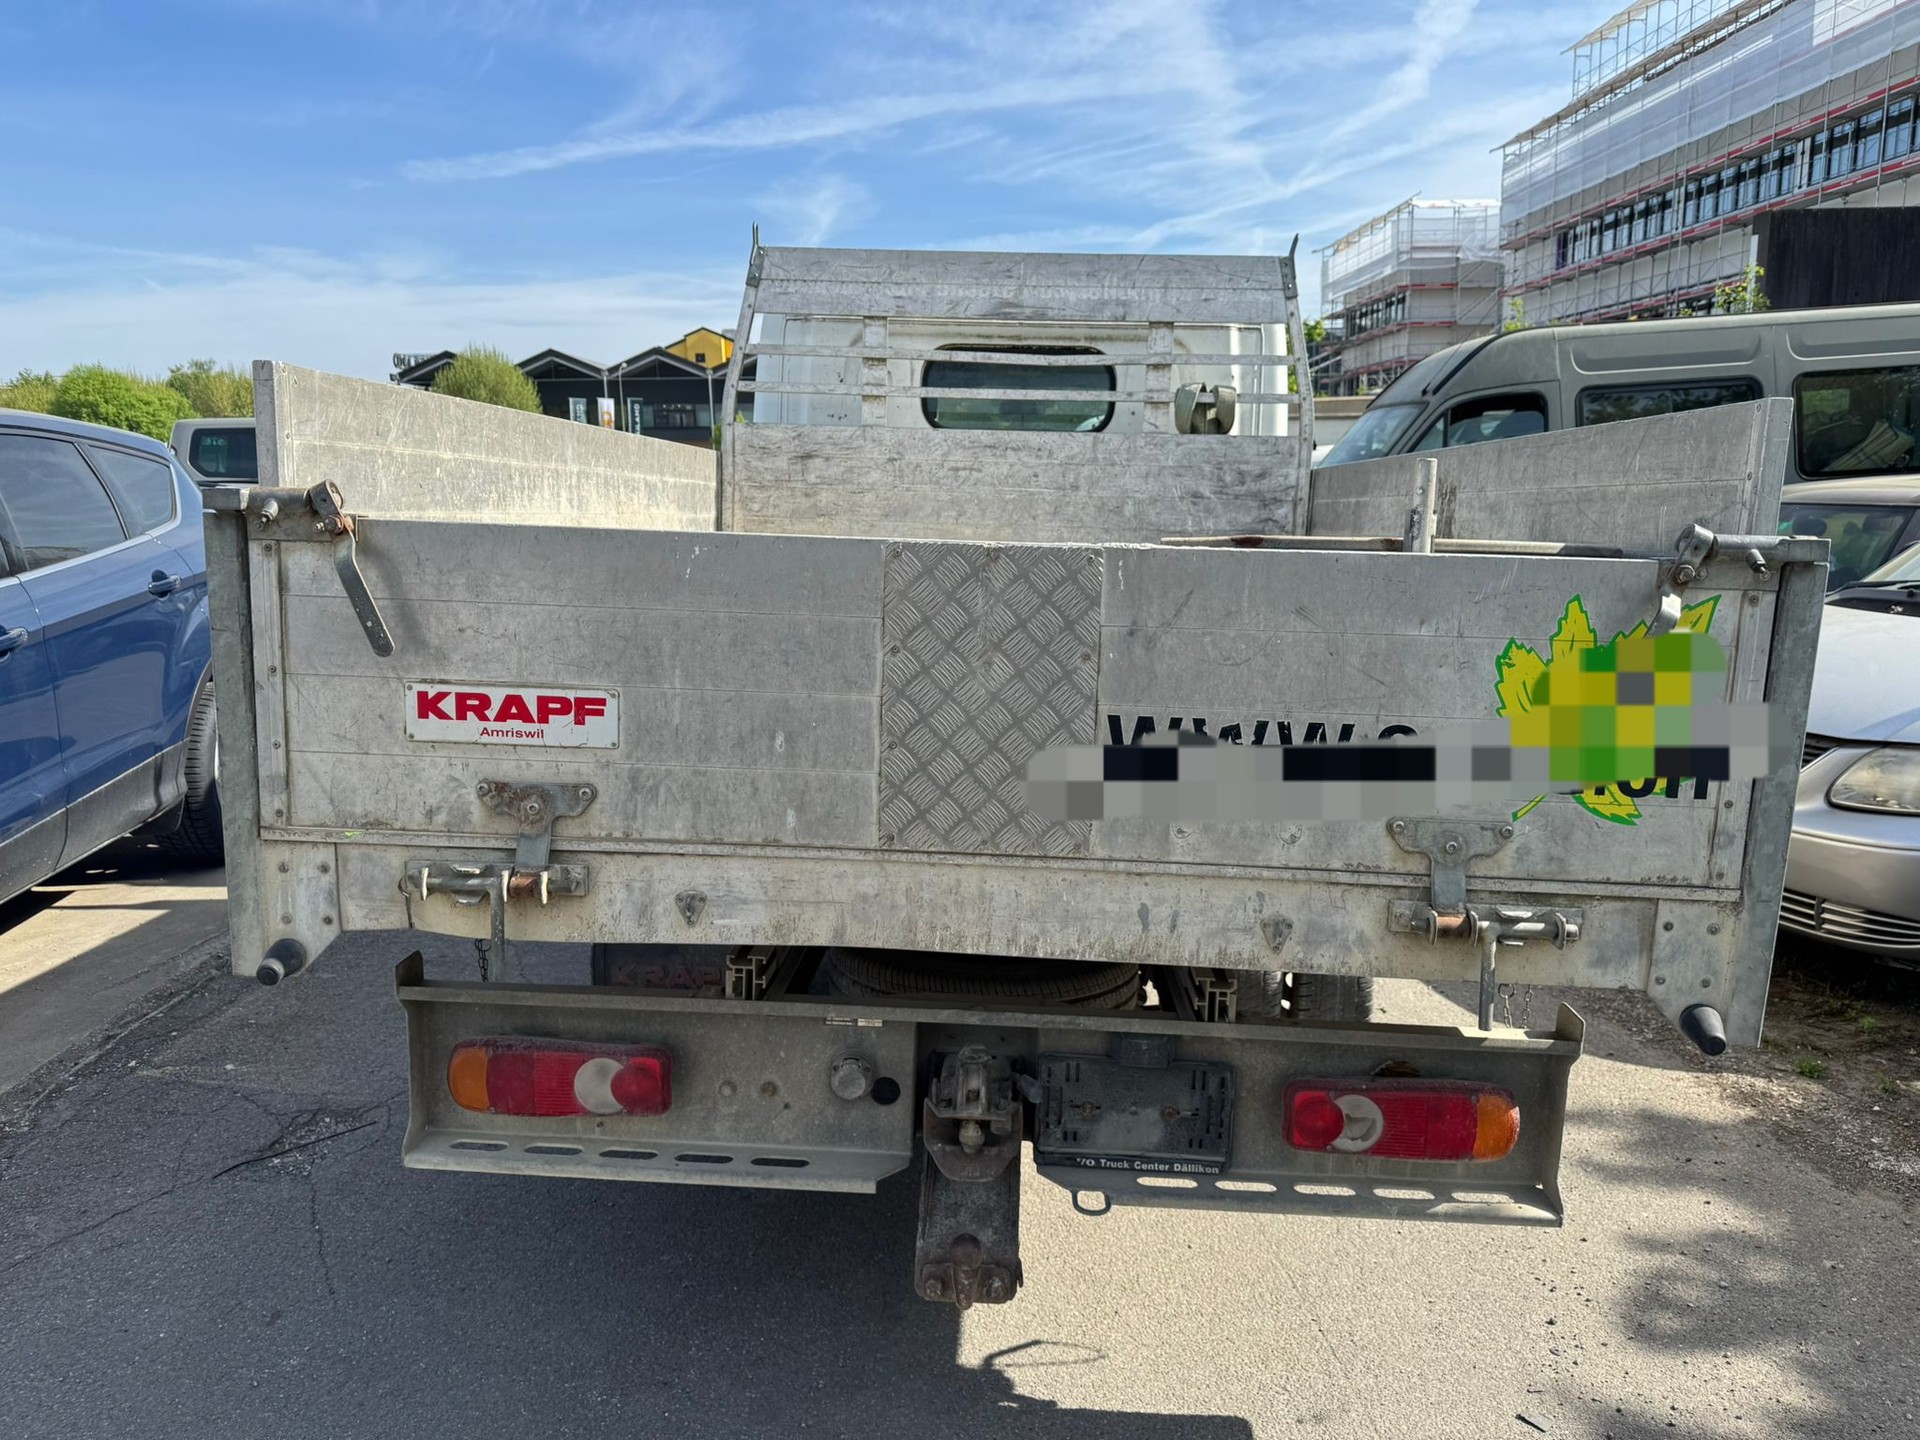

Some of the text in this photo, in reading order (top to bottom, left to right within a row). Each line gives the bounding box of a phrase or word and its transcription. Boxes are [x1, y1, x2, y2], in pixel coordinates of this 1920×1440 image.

[416, 690, 607, 726] KRAPF
[480, 727, 545, 739] Amriswil
[1100, 1158, 1130, 1169] Truck
[1134, 1160, 1170, 1172] Center
[1173, 1162, 1220, 1175] Dällikon
